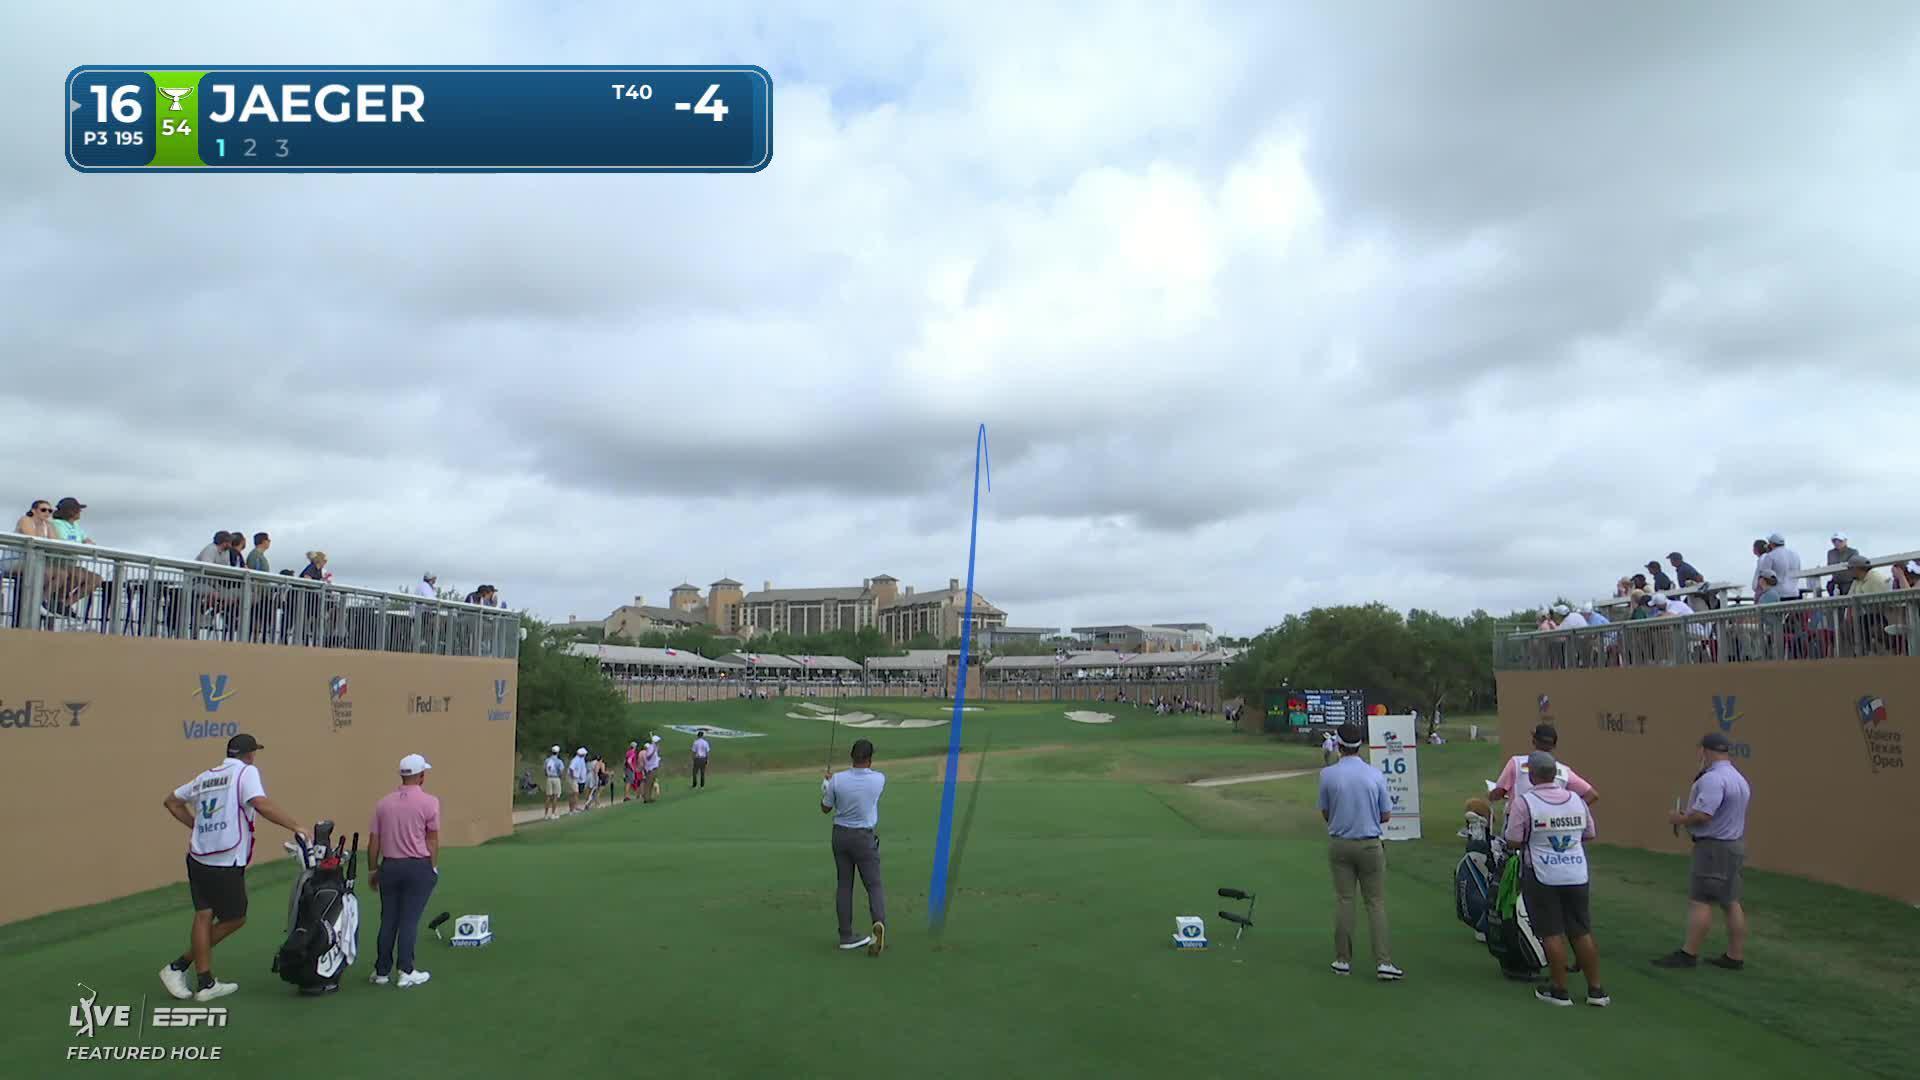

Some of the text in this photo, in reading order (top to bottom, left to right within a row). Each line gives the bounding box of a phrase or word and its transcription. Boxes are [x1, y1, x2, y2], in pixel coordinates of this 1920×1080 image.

[0, 700, 61, 728] edEx
[183, 720, 238, 739] Valero
[1870, 742, 1903, 754] Texas
[1381, 757, 1406, 774] 16
[1873, 755, 1904, 769] Open
[198, 820, 228, 834] alero
[1550, 816, 1582, 829] HOSSLER
[1540, 853, 1583, 865] Valero
